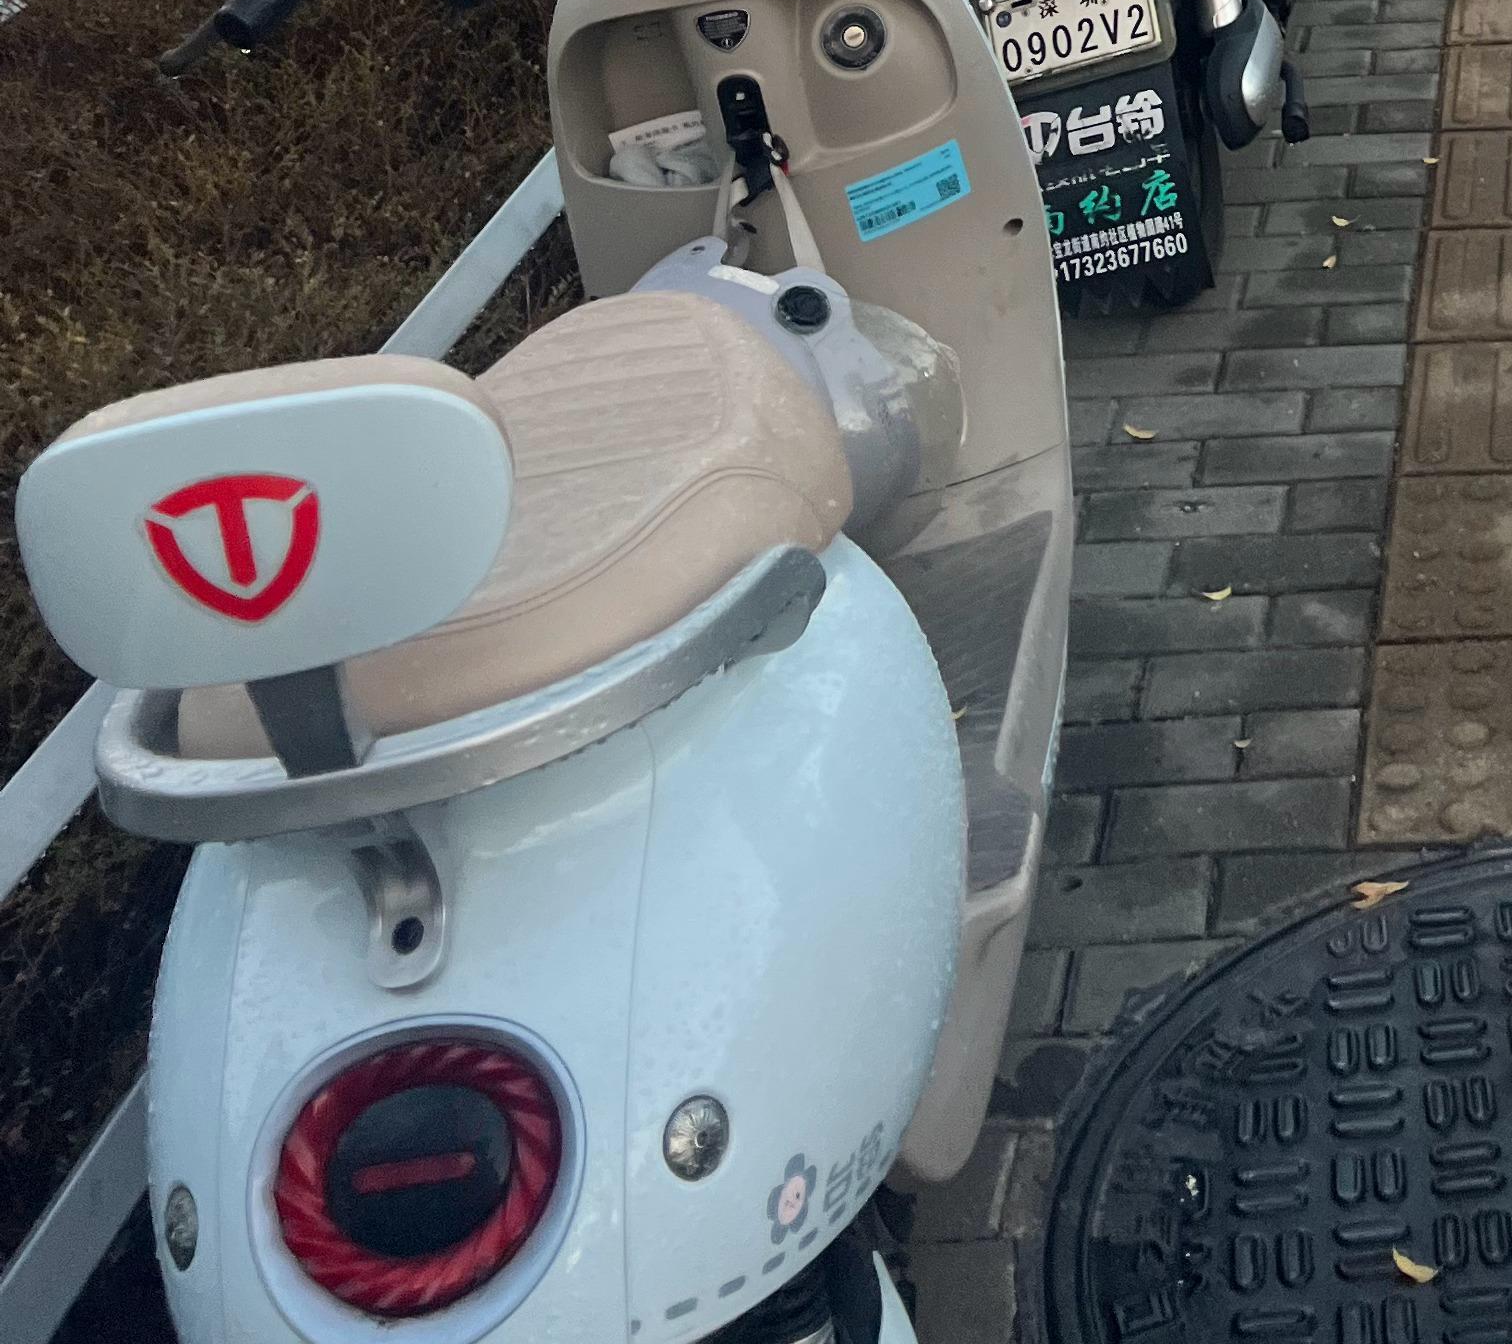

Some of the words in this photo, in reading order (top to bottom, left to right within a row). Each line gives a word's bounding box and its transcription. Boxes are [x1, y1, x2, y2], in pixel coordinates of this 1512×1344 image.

[1002, 3, 1149, 73] 0902V2
[1065, 89, 1165, 156] 台铃
[1059, 232, 1189, 282] 17323677660
